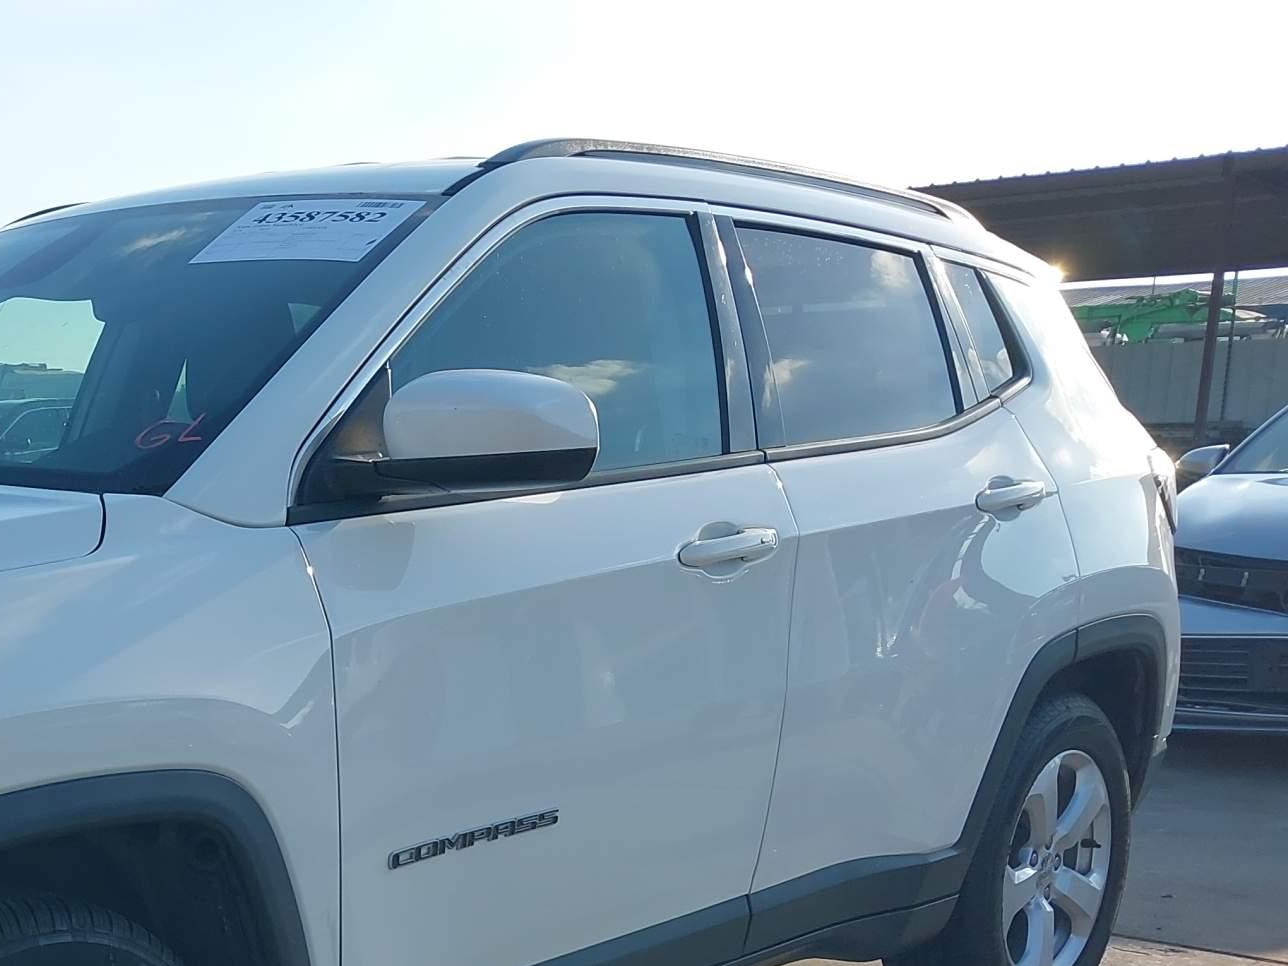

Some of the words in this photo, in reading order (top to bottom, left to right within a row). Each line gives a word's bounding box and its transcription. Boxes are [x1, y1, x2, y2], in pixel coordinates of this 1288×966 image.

[253, 211, 387, 225] 43587582
[135, 412, 206, 449] GL
[388, 807, 560, 870] COMPASS
